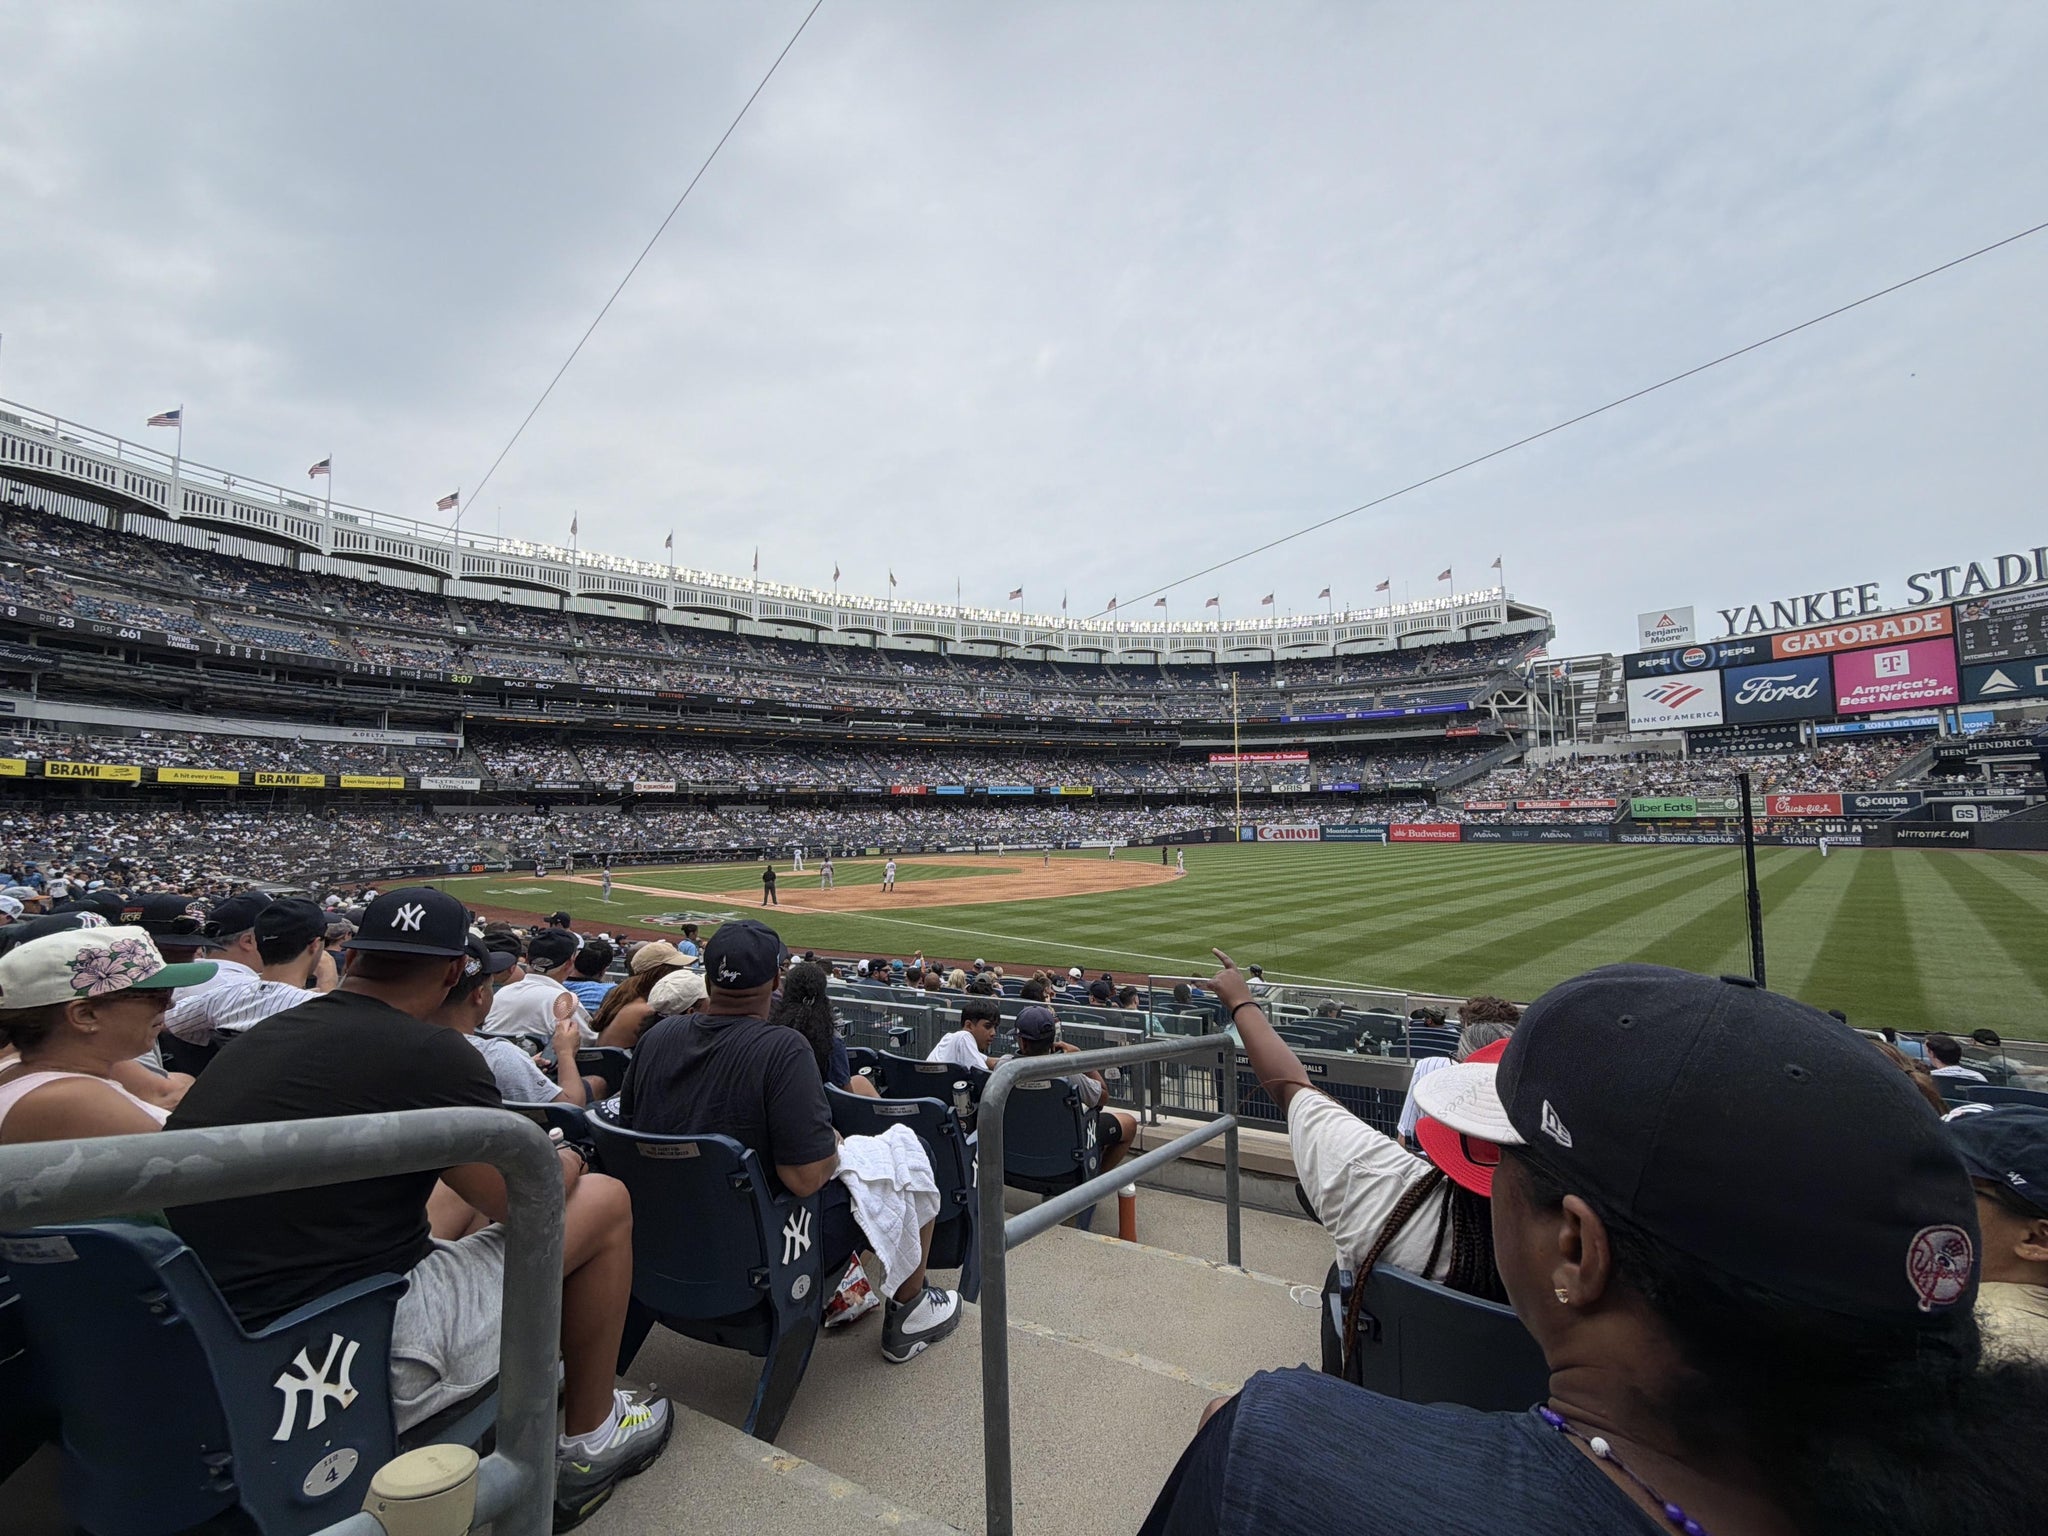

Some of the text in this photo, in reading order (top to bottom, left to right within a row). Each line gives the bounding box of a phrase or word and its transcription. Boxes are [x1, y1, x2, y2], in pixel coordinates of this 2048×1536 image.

[8, 606, 17, 617] 8
[1716, 582, 1882, 637] YANKEE
[39, 613, 75, 629] RBI 23
[93, 624, 142, 640] OPS .661
[1645, 625, 1689, 637] Benjamin
[1782, 612, 1943, 652] GATORADE
[167, 634, 191, 644] TWINS
[1650, 634, 1681, 643] Moore
[166, 640, 200, 652] YANKEES
[1638, 657, 1671, 668] PEPSI
[1719, 646, 1756, 658] PEPSI
[451, 674, 473, 684] 3:07
[504, 680, 556, 690] BAD BOY
[1735, 674, 1819, 705] Ford
[1852, 678, 1938, 695] America's
[1840, 685, 1954, 706] Best Network
[1631, 716, 1657, 724] BANK
[1672, 711, 1720, 722] AMERICA
[1821, 725, 1845, 733] WAVE
[1865, 720, 1891, 730] KONA
[1893, 718, 1910, 727] BIG
[1911, 717, 1939, 726] WAVE
[1969, 739, 2033, 750] HENDRICK
[50, 763, 100, 777] BRAMI
[259, 774, 300, 784] BRAMI
[900, 786, 919, 794] AVIS
[1279, 784, 1303, 792] ORIS
[1872, 795, 1908, 805] coupa
[1634, 803, 1661, 813] Uber
[1664, 801, 1693, 812] Eats
[1956, 809, 1974, 818] GS
[1258, 826, 1319, 840] Canon
[1473, 830, 1500, 838] MOANA
[1540, 830, 1571, 838] MOANA
[1897, 830, 1969, 840] NITTOTIRE.COM
[1621, 835, 1734, 844] StubHub StubHub StubHub
[1782, 836, 1817, 844] STARR
[391, 902, 426, 931] NY
[1235, 1056, 1249, 1064] LERT
[782, 1206, 812, 1266] NY
[272, 1333, 360, 1441] NY
[325, 1467, 338, 1483] 4
